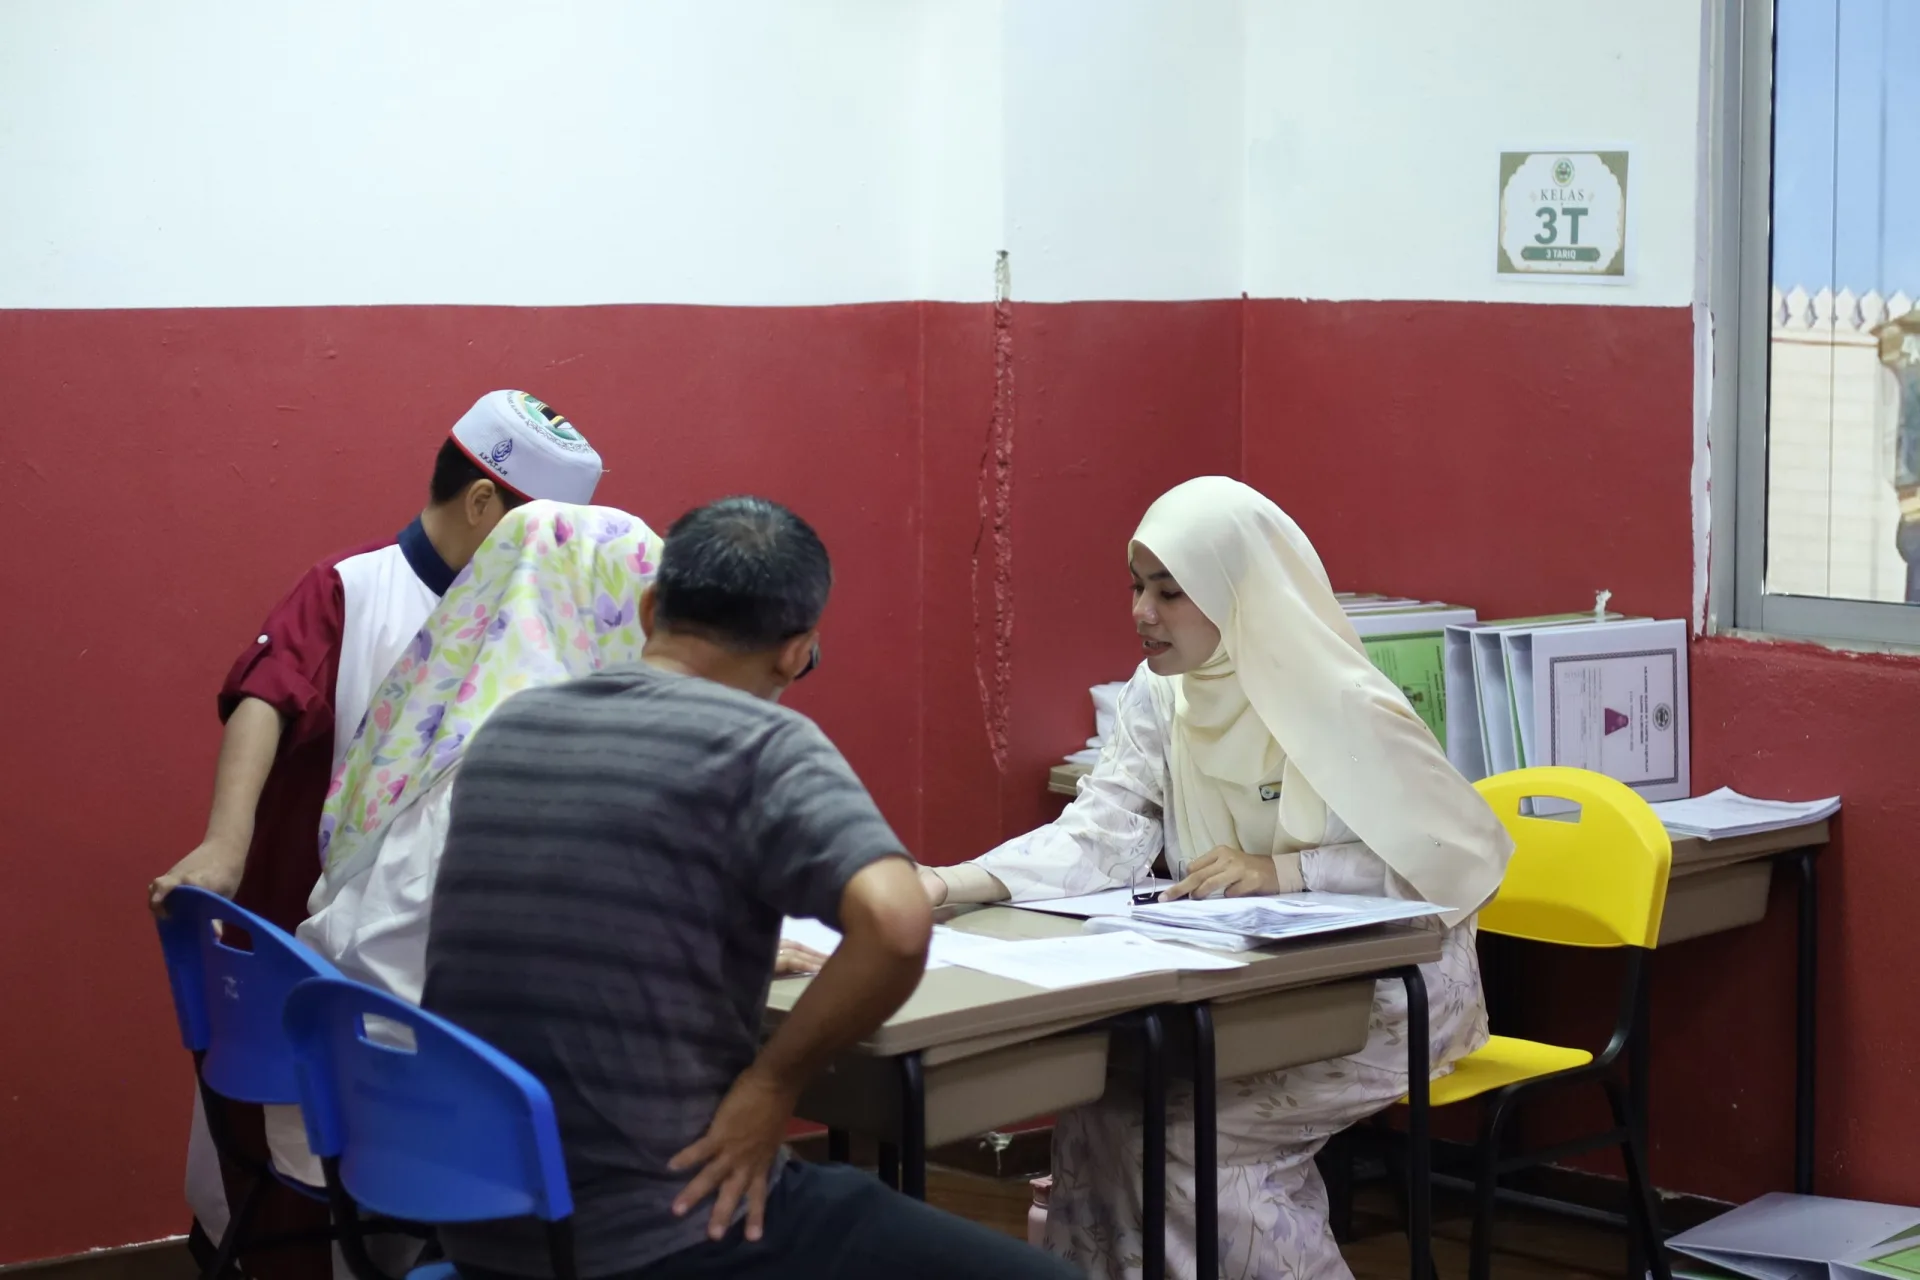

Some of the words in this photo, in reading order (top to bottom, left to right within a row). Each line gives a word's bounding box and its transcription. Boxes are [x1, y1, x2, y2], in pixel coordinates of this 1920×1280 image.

[1540, 189, 1585, 201] KELAS
[1534, 206, 1589, 245] 3T
[1546, 250, 1552, 259] 3
[1553, 250, 1577, 260] TARIQ
